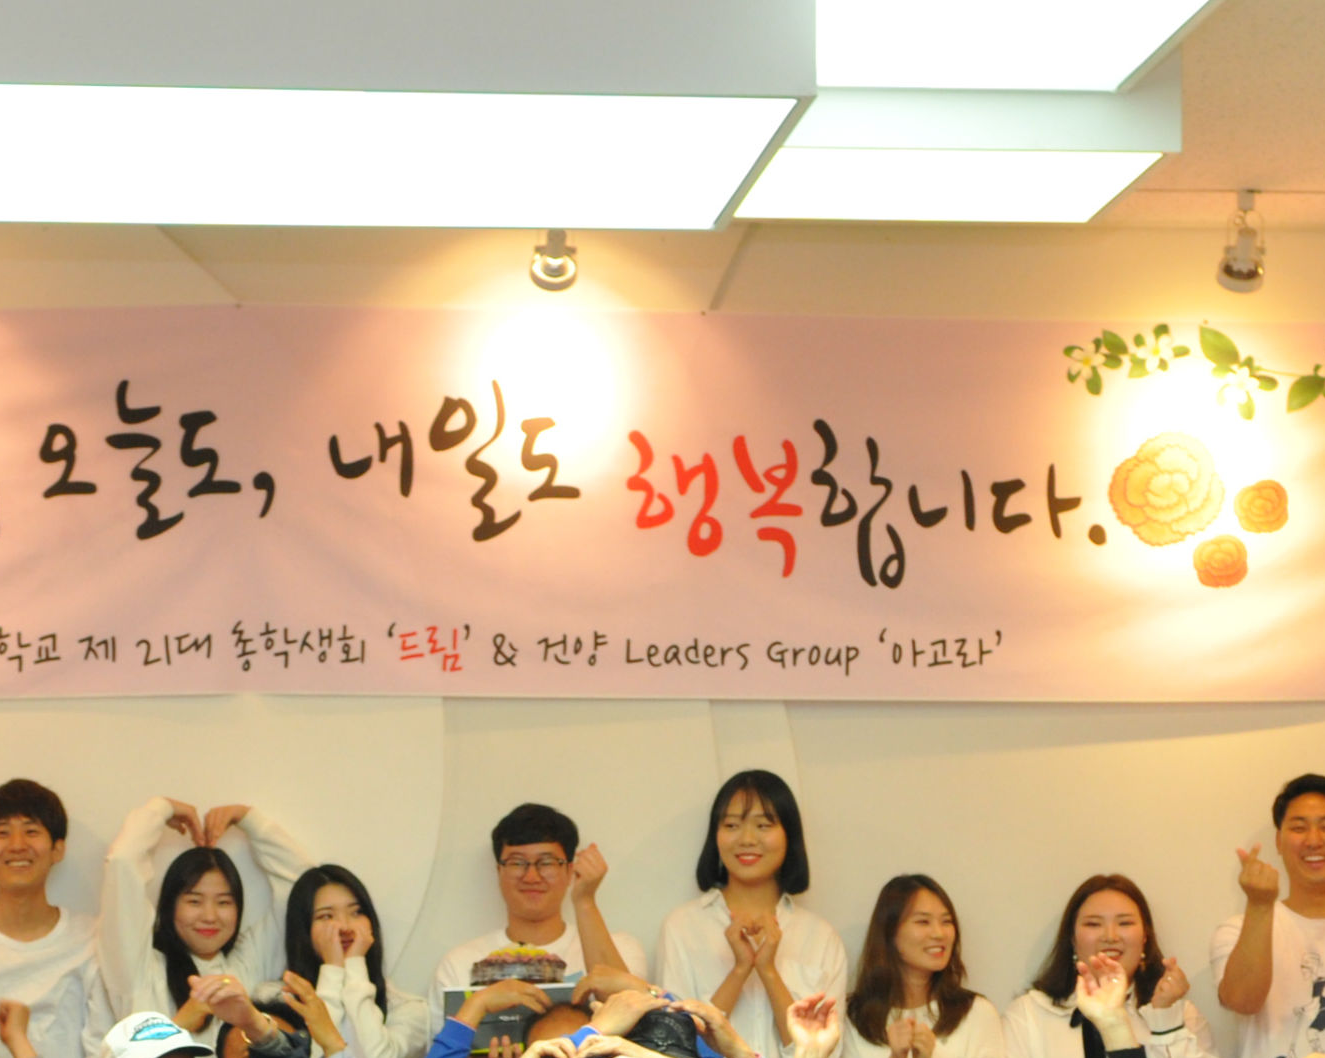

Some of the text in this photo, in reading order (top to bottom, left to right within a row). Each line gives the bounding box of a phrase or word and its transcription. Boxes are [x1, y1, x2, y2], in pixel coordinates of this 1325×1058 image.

[38, 380, 277, 542] 오늘도,
[328, 379, 582, 543] 내일도
[625, 418, 1108, 590] 행복합니다.
[77, 635, 117, 663] 제
[135, 633, 213, 667] 21대
[231, 620, 366, 673] 총학생회
[492, 632, 519, 667] &
[536, 630, 609, 667] 건양
[625, 637, 751, 671] Leaders
[766, 640, 860, 677] Group
